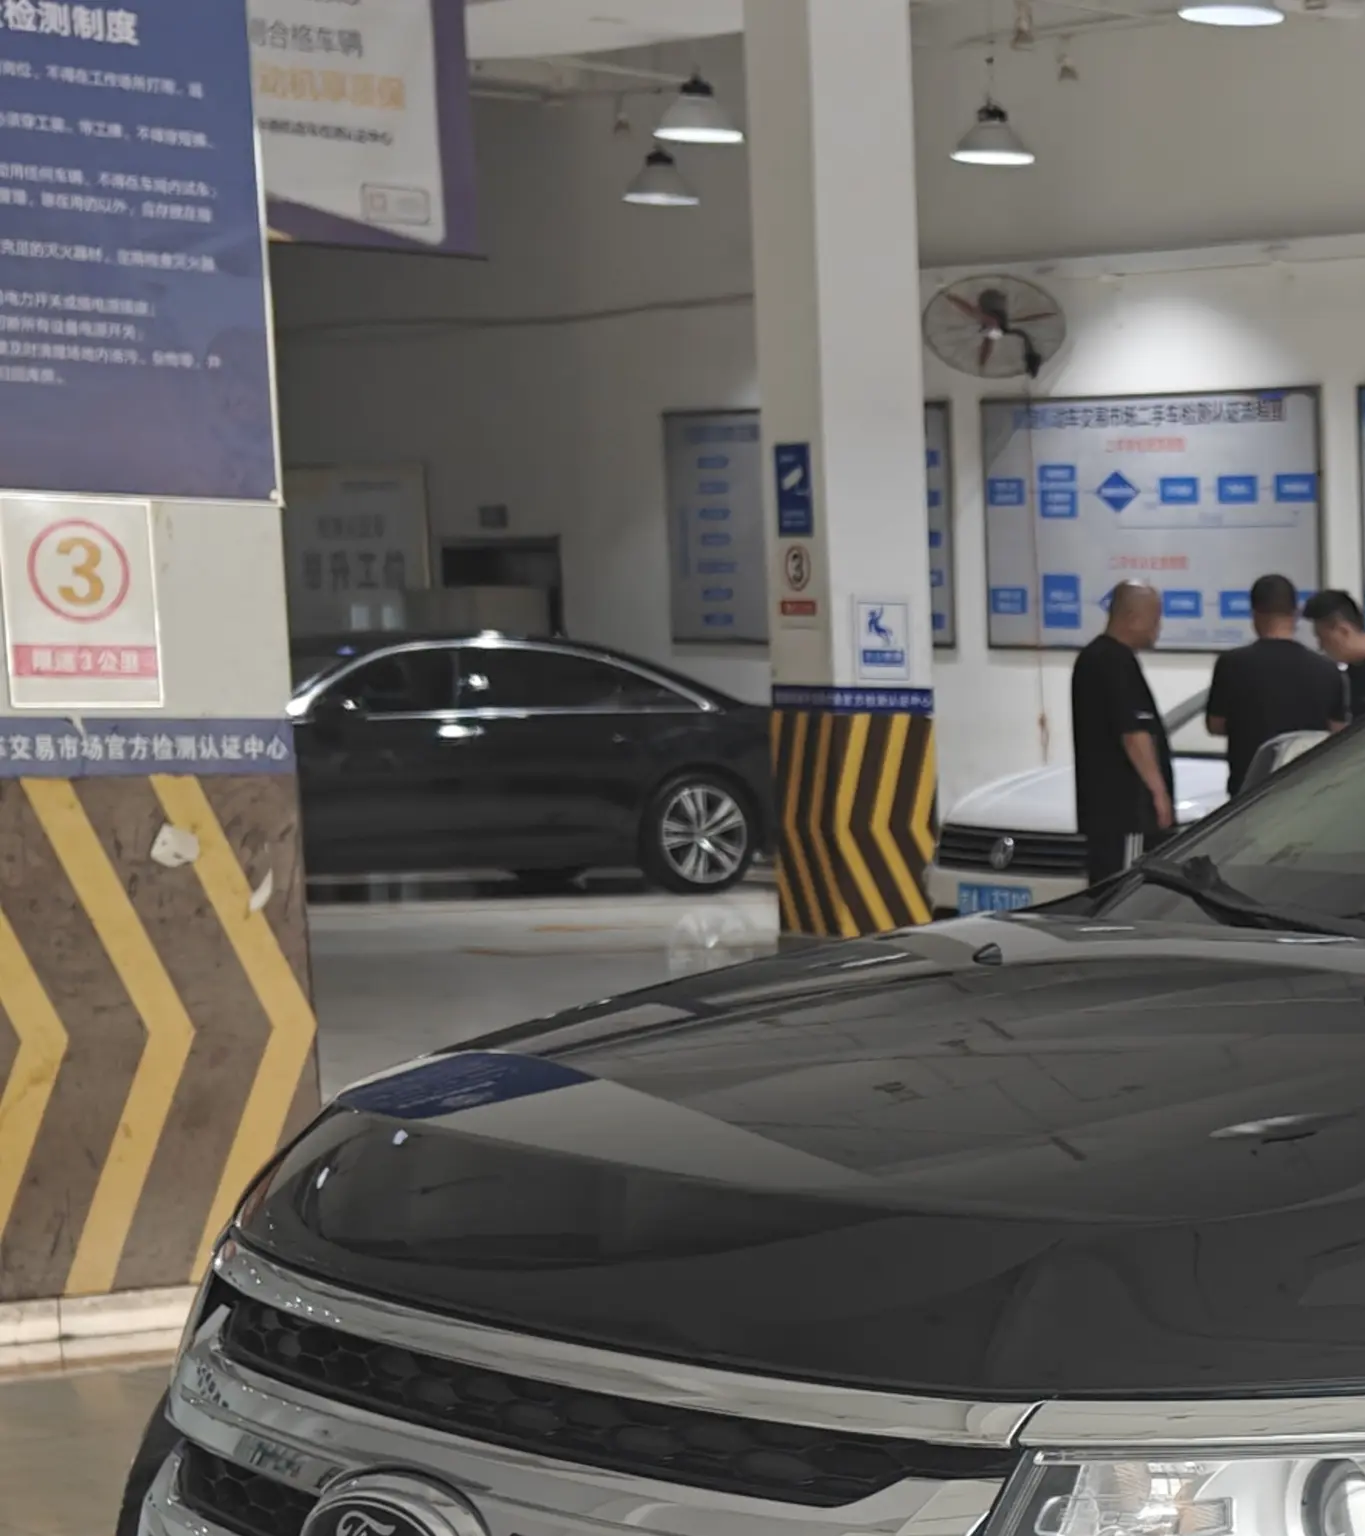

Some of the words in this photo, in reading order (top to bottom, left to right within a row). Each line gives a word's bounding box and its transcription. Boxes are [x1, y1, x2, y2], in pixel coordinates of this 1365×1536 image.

[0, 0, 140, 46] 检测制度
[56, 537, 104, 607] 3
[32, 650, 139, 672] 限速3公里
